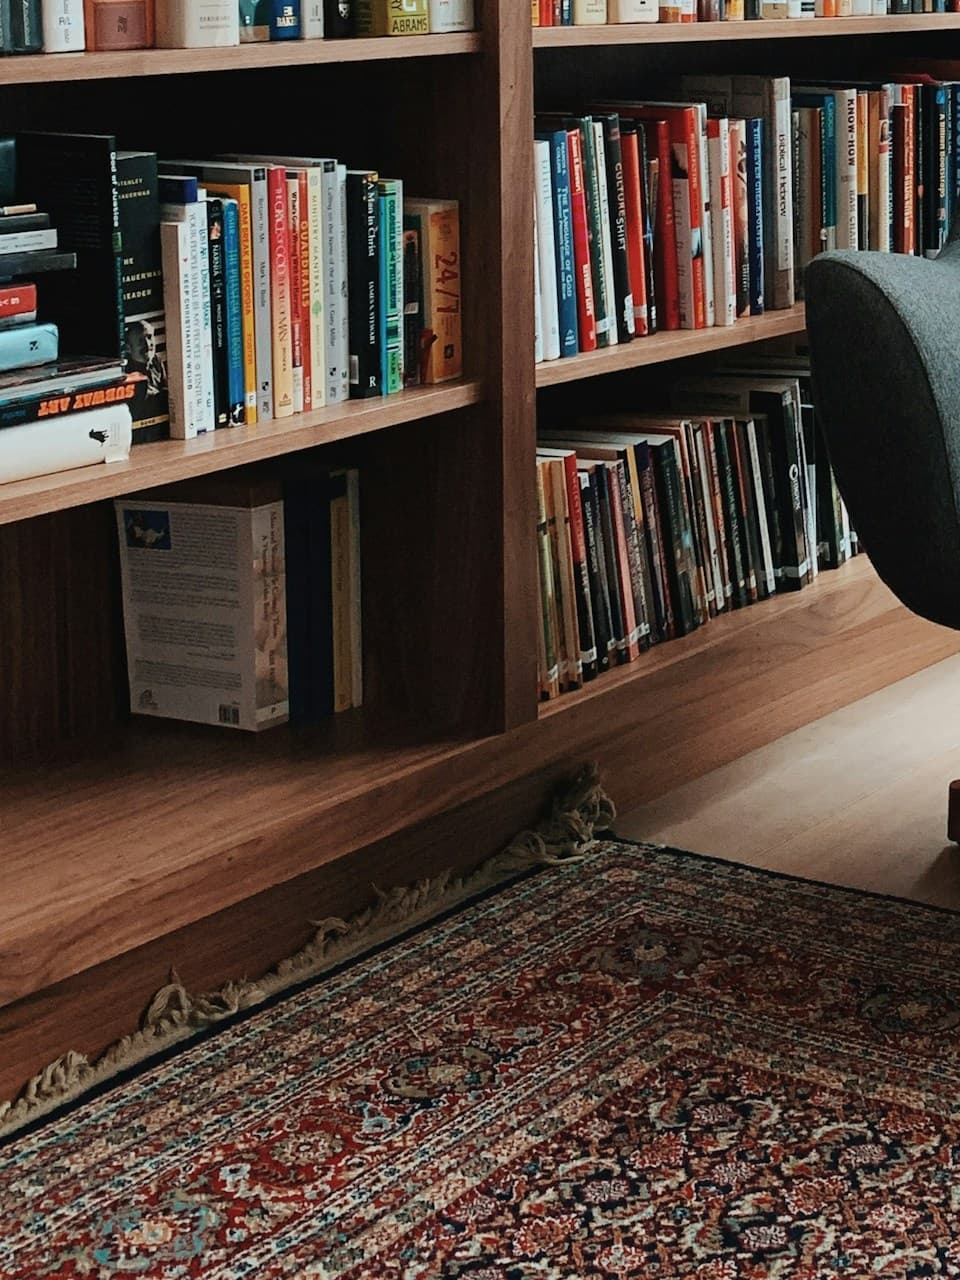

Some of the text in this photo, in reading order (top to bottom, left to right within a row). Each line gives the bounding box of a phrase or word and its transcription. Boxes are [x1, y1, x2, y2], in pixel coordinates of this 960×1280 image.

[392, 20, 427, 33] ABRAMS
[847, 99, 856, 167] KNOW-HOW
[112, 175, 118, 185] of
[561, 186, 569, 206] THE
[779, 134, 788, 217] Biblical Hebrew
[938, 151, 946, 198] Bootstraps
[367, 182, 377, 256] A Man in Christ
[615, 162, 626, 251] CULTURESHIFT
[311, 195, 320, 294] MINISTRY MANTRAS
[562, 208, 570, 257] LANGUAGE
[211, 245, 221, 276] NARNIA
[300, 221, 310, 308] GUARDRAILS
[435, 251, 459, 315] 24/7
[564, 259, 571, 272] OF
[565, 274, 573, 297] GOD
[37, 383, 136, 417] SUBWAY ART
